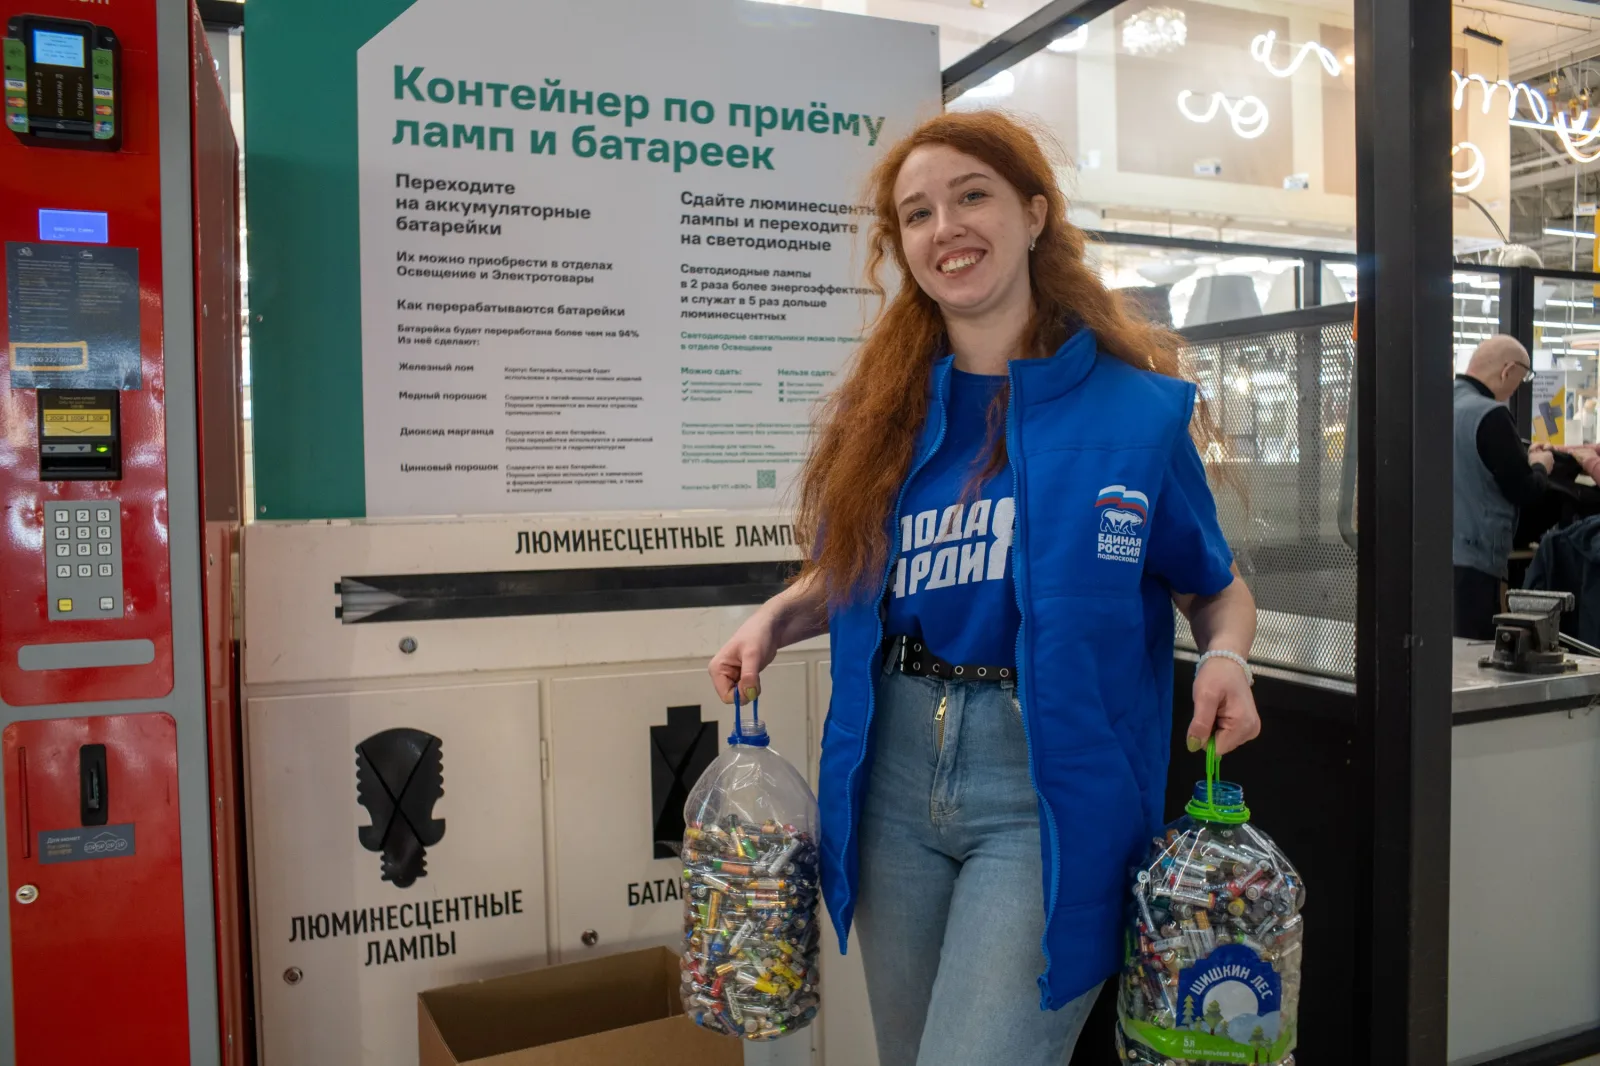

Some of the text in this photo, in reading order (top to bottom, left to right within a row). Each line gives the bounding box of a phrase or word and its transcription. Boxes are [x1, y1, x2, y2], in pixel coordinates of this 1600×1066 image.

[393, 66, 957, 146] Контейнер по приёму
[391, 120, 774, 172] ламп и батареек
[395, 173, 515, 194] Переходите
[680, 191, 744, 207] Сдайте
[395, 198, 590, 219] на аккумуляторные
[395, 216, 501, 235] батарейки
[680, 214, 858, 233] лампы и переходите
[680, 234, 831, 251] на светодиодные
[396, 250, 612, 270] Их можно приобрести в отделах
[396, 266, 594, 284] Освещение и Электротовары
[680, 263, 811, 278] Светодиодные лампы
[680, 281, 687, 289] в
[690, 279, 697, 289] 2
[700, 281, 728, 291] раза
[732, 280, 767, 291] более
[396, 299, 625, 316] Как перерабатываются батарейки
[680, 295, 688, 303] и
[691, 296, 736, 305] служат
[748, 295, 756, 305] 5
[758, 298, 779, 307] раз
[781, 299, 827, 307] дольше
[680, 310, 786, 320] люминесцентных
[397, 323, 451, 334] Батарейка
[453, 325, 481, 335] будет
[484, 327, 552, 336] переработана
[554, 328, 583, 336] более
[617, 329, 639, 337] 94%
[397, 335, 411, 344] Из
[413, 336, 432, 344] неё
[398, 362, 452, 371] Железный
[398, 391, 486, 401] Медный порошок
[399, 427, 494, 436] Диоксид марганца
[400, 463, 498, 472] Цинковый порошок
[100, 511, 107, 519] 3
[100, 528, 108, 536] 6
[515, 526, 725, 553] ЛЮМИНЕСЦЕНТНЫЕ
[1098, 533, 1142, 548] ЕДИНАЯ
[60, 546, 67, 554] 7
[101, 545, 108, 553] 9
[1097, 542, 1141, 557] РОССИЯ
[1097, 553, 1139, 564] ПОДМОСКОВЬЕ
[288, 891, 522, 940] ЛЮМИНЕСЦЕНТНЫЕ
[364, 931, 456, 964] ЛАМПЫ
[1189, 964, 1274, 1000] ШИШКИН ЛЕС
